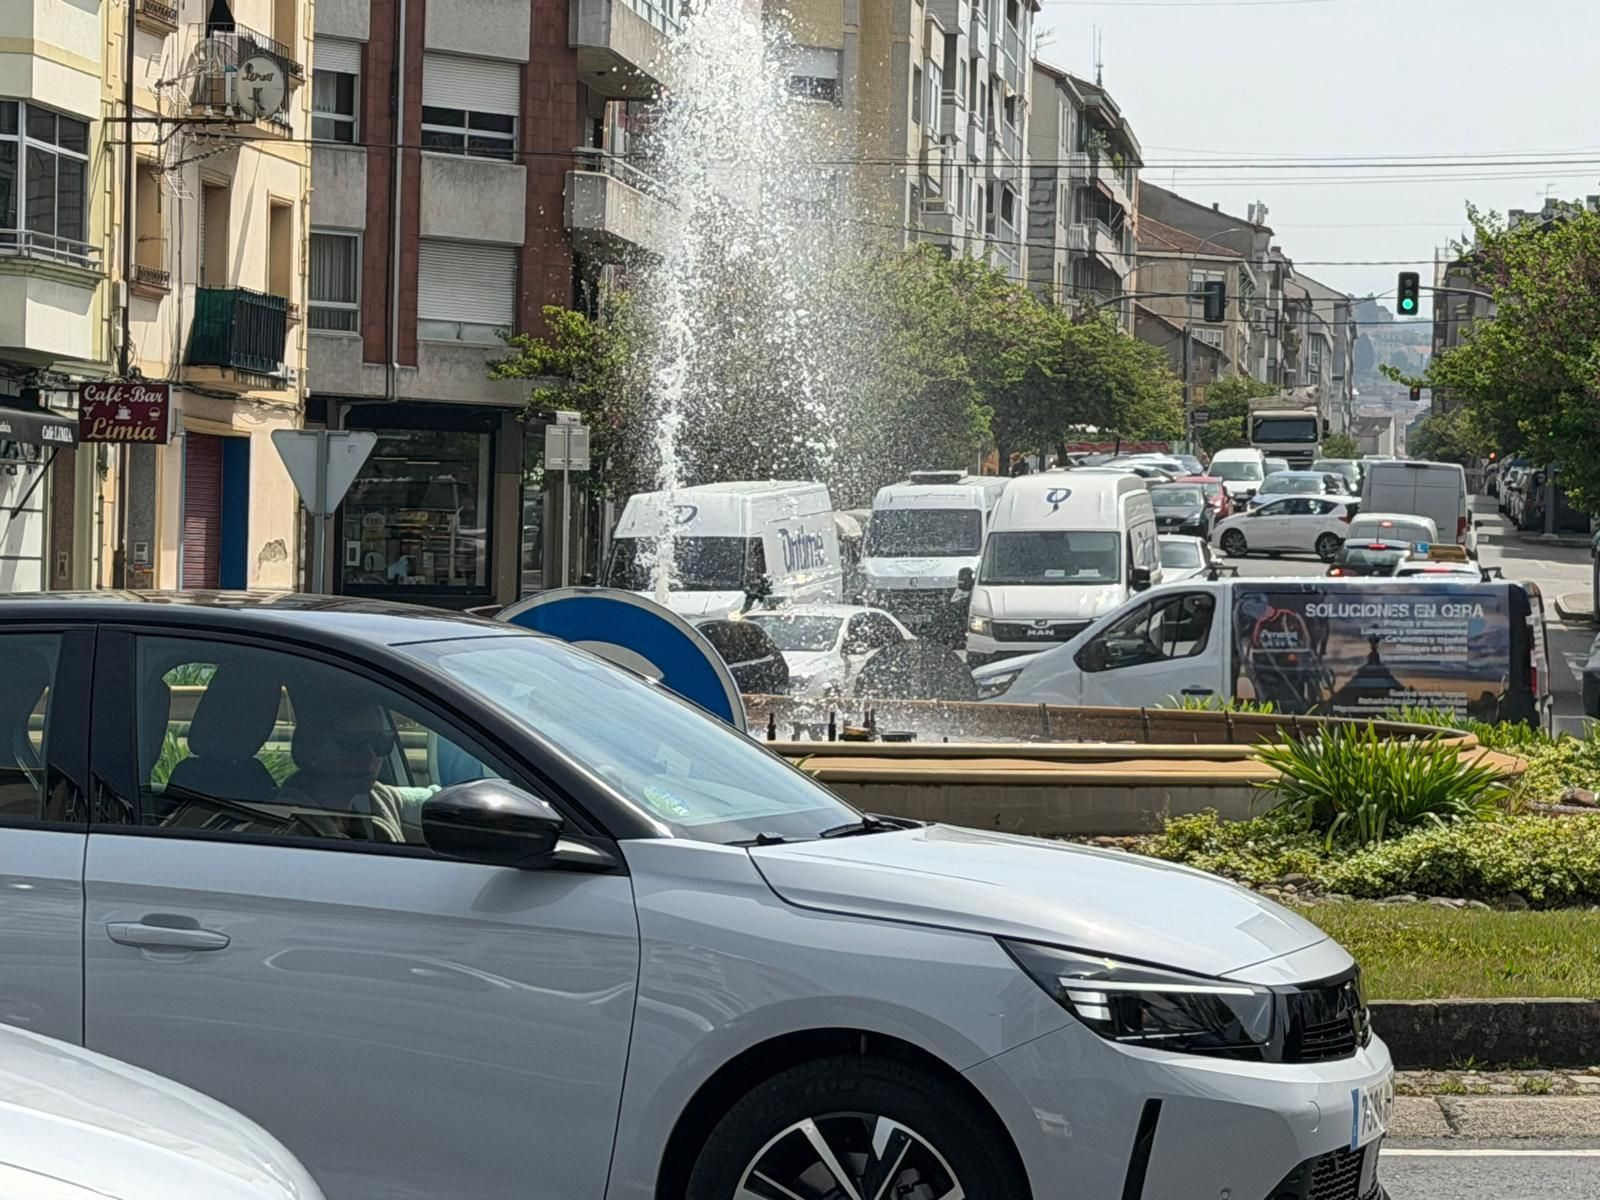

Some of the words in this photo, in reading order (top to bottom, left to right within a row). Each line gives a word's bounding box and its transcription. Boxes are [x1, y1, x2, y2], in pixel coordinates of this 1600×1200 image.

[84, 385, 164, 406] Café-Bar
[87, 417, 157, 441] Limia
[1305, 603, 1410, 618] SOLUCIONES
[1414, 603, 1437, 618] EN
